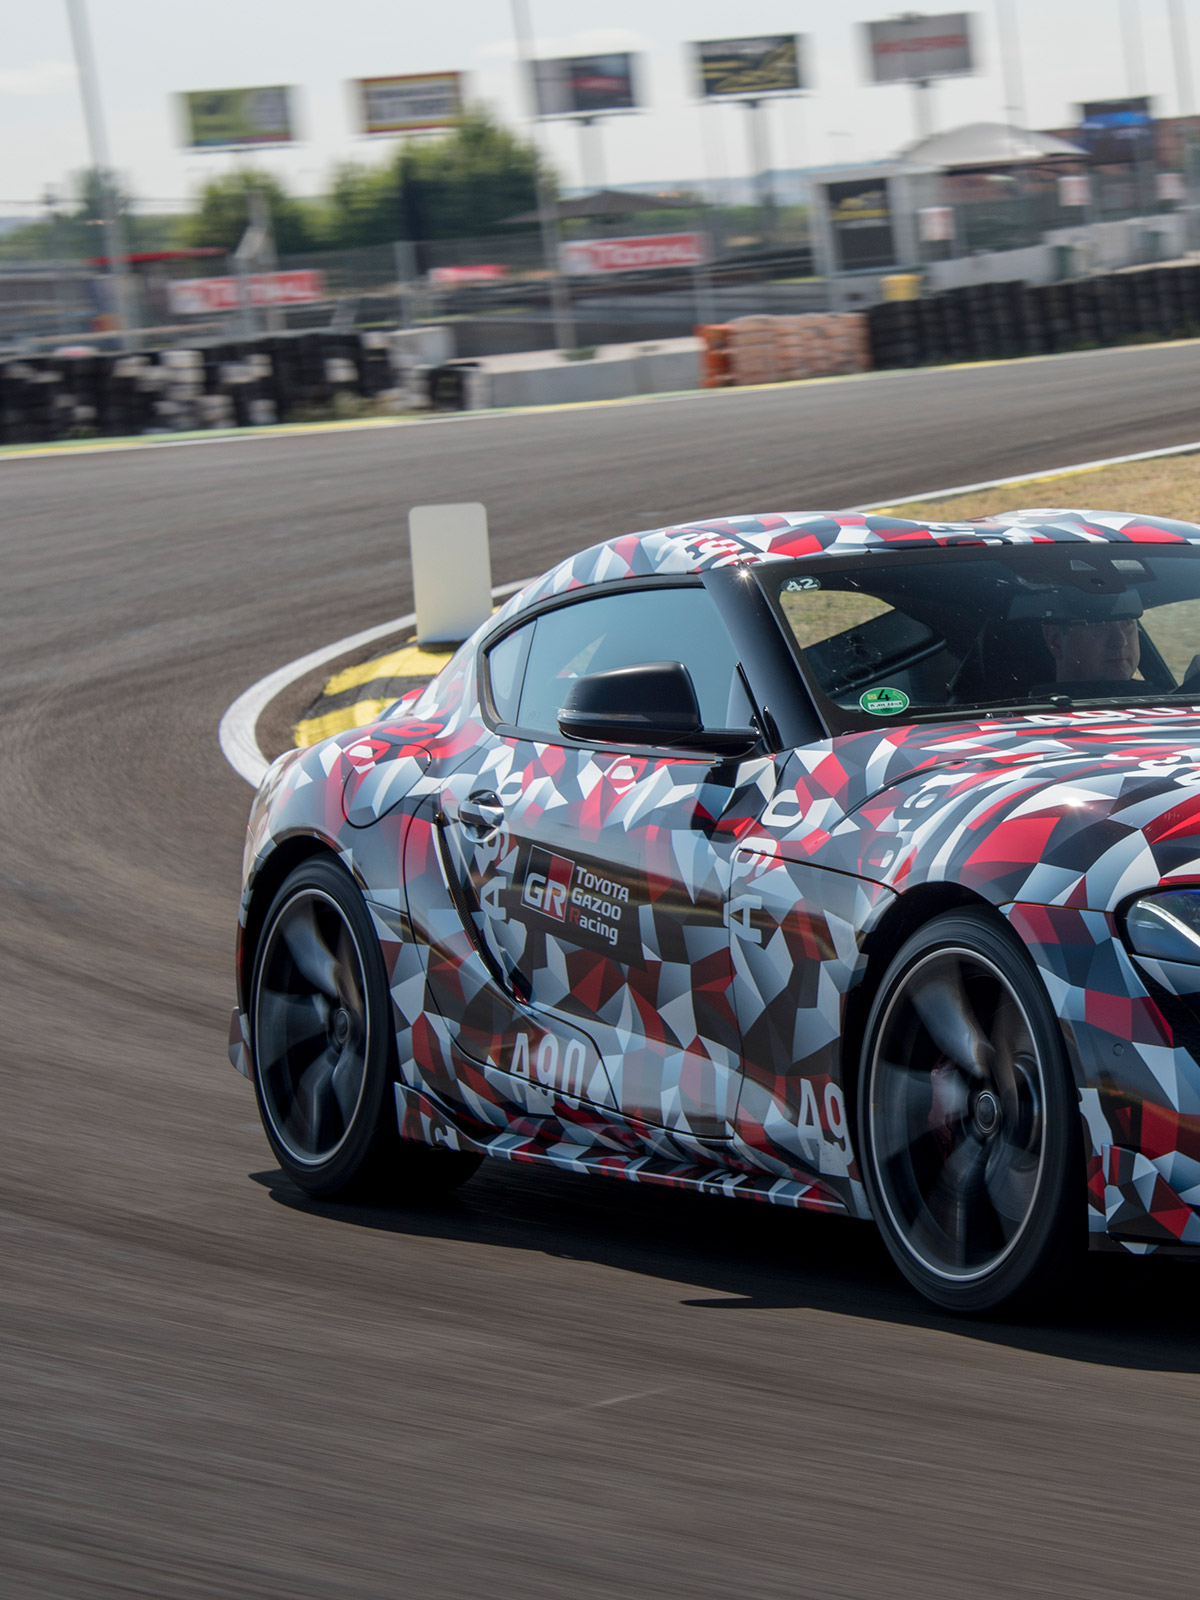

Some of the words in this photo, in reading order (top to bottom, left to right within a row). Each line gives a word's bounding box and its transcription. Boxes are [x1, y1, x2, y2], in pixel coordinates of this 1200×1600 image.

[786, 577, 818, 592] 42
[877, 689, 892, 702] 4
[575, 865, 630, 903] TOYOTA
[722, 788, 804, 944] A90
[523, 871, 568, 918] GR
[571, 887, 622, 921] GAZOO
[568, 906, 619, 946] Racing
[509, 1032, 587, 1111] A90
